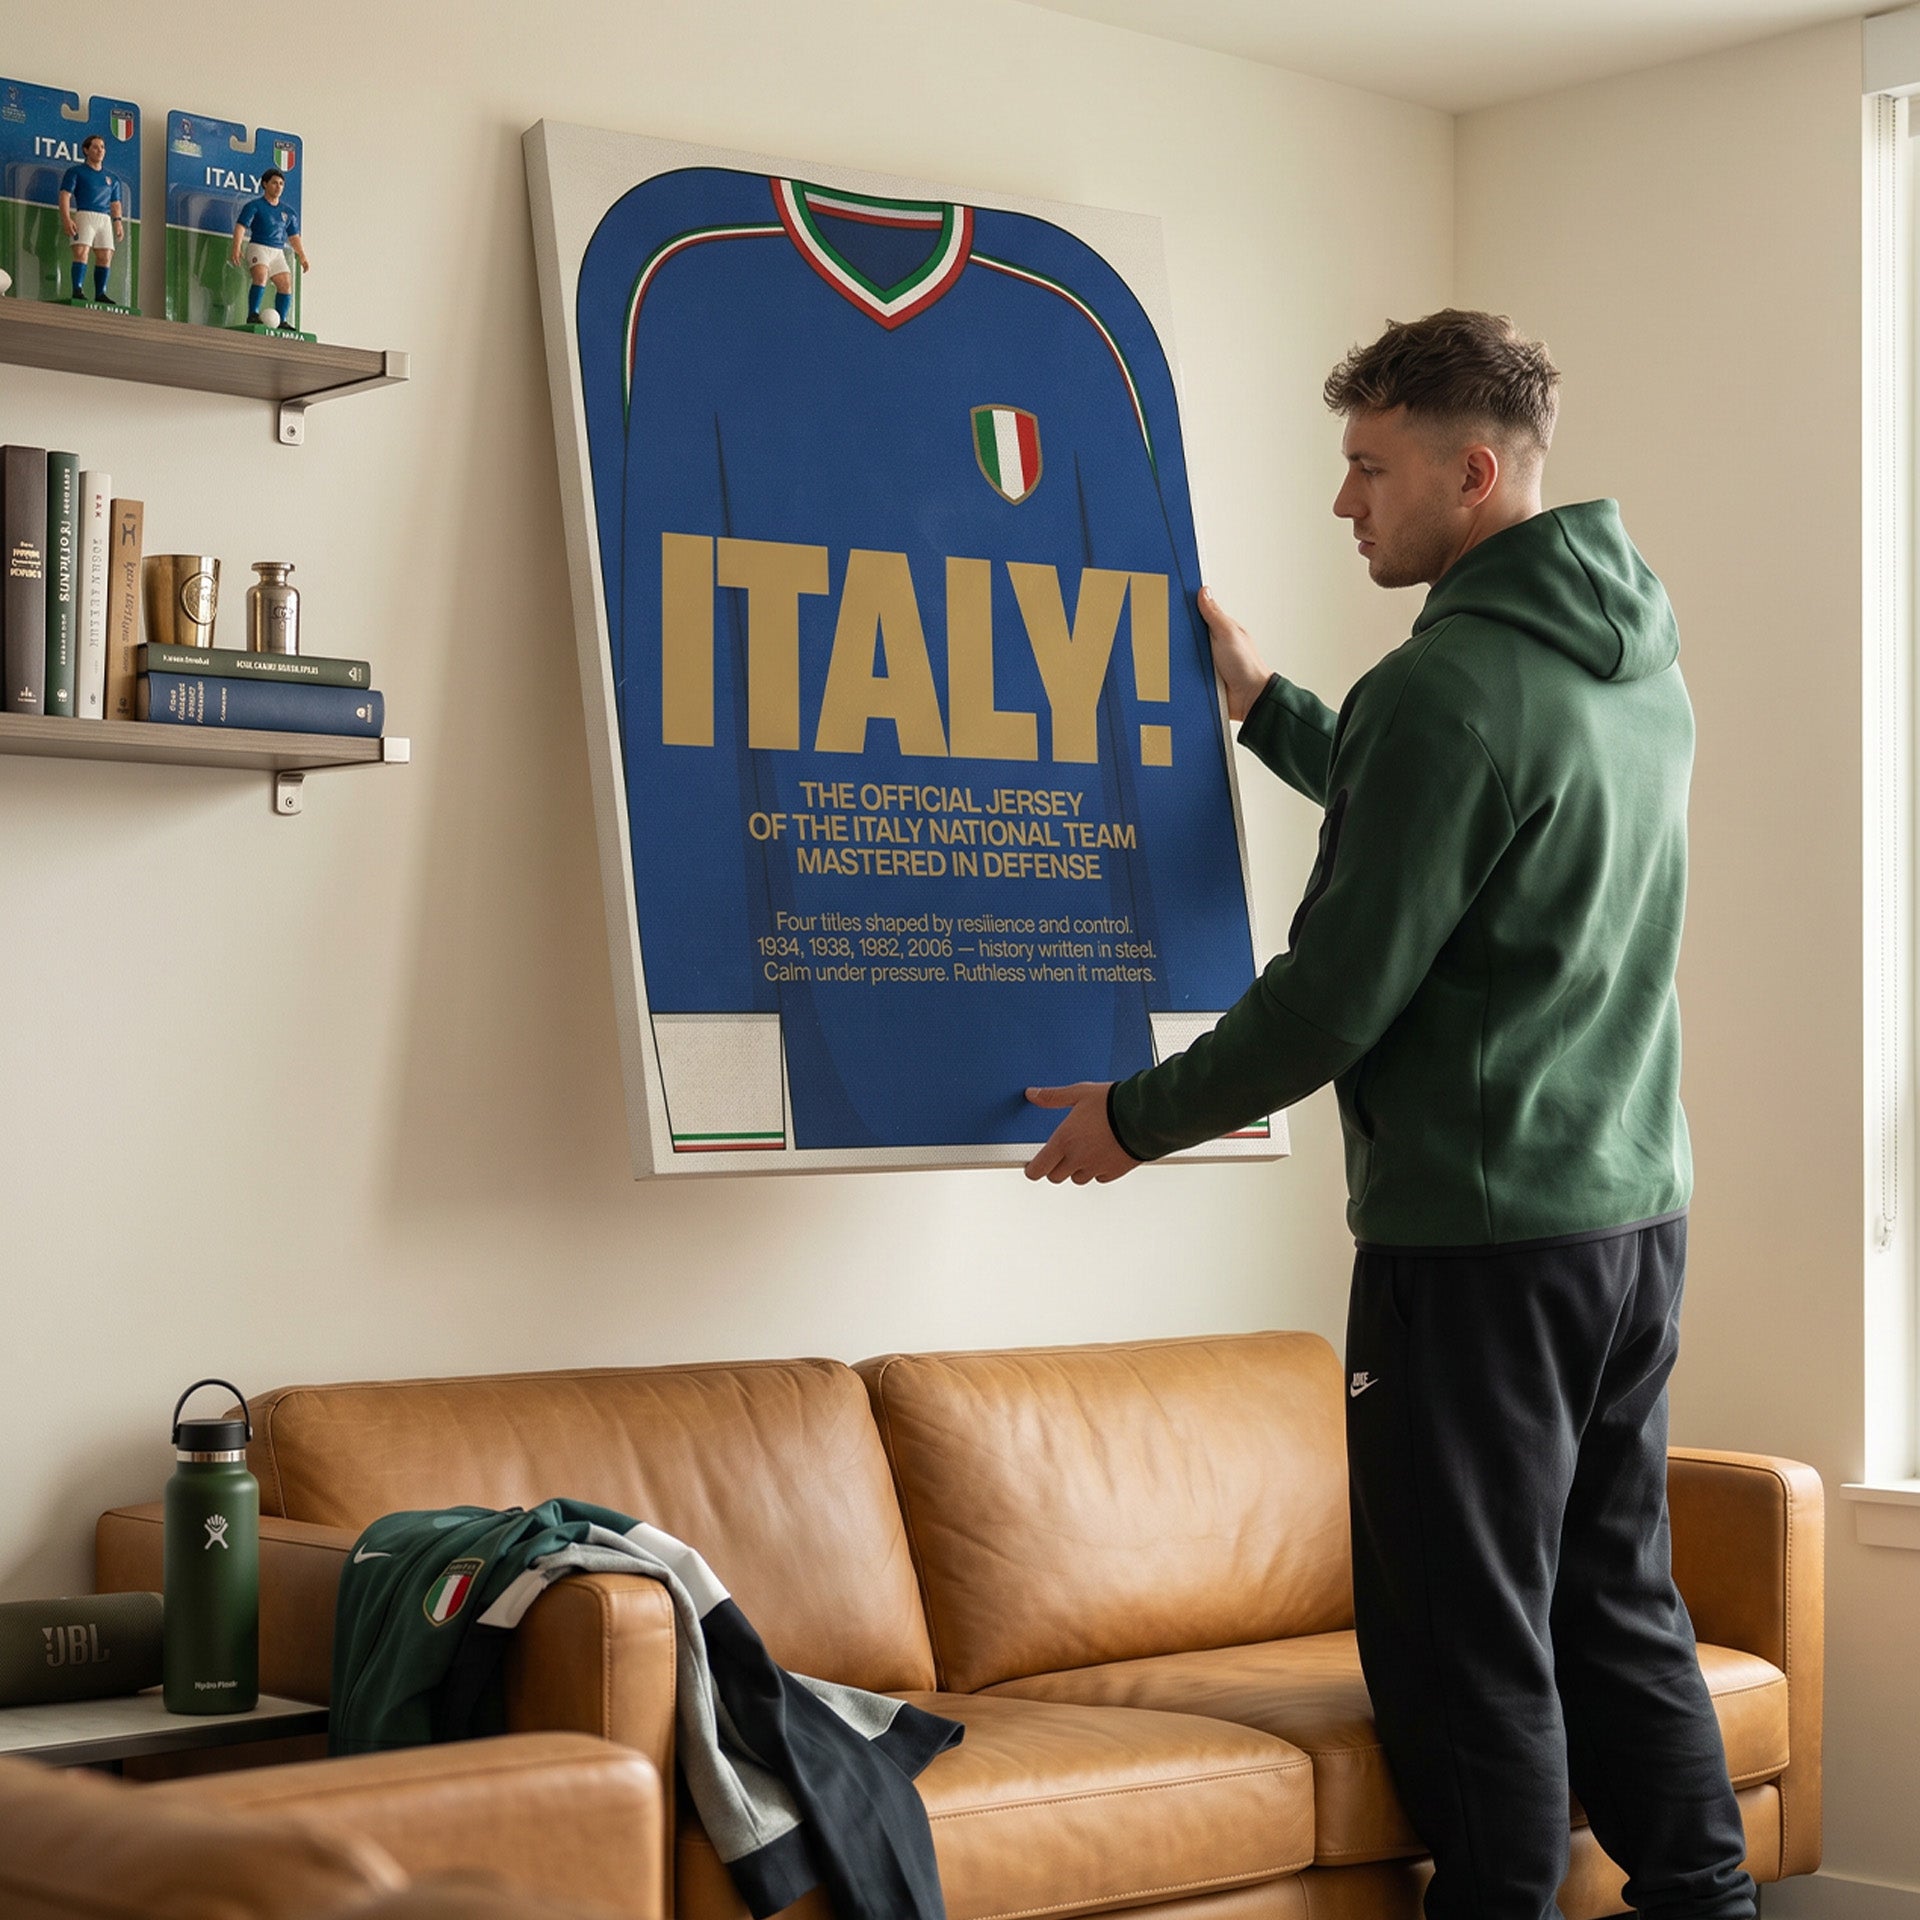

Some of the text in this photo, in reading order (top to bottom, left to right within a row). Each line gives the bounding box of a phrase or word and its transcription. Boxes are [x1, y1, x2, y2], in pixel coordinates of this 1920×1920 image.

[34, 135, 86, 164] ITAL
[206, 166, 262, 195] ITALY
[662, 532, 1173, 767] ITALY!
[799, 782, 1083, 817] THE OFFICIAL JERSEY
[748, 812, 1137, 850] OF THE ITALY NATIONAL TEAM
[796, 846, 1103, 881] MASTERED IN DEFENSE
[775, 911, 1134, 936] Four titles shaped by resilience and control.
[758, 936, 805, 960] 1934,
[810, 937, 855, 960] 1938,
[860, 937, 904, 960] 1982,
[908, 937, 953, 958] 2006
[979, 938, 1035, 961] history
[1038, 939, 1095, 958] written
[1097, 940, 1112, 958] in
[1115, 940, 1156, 959] steel.
[763, 960, 1157, 985] Calm under pressure. Ruthless when it matters.
[42, 1624, 110, 1667] JBL
